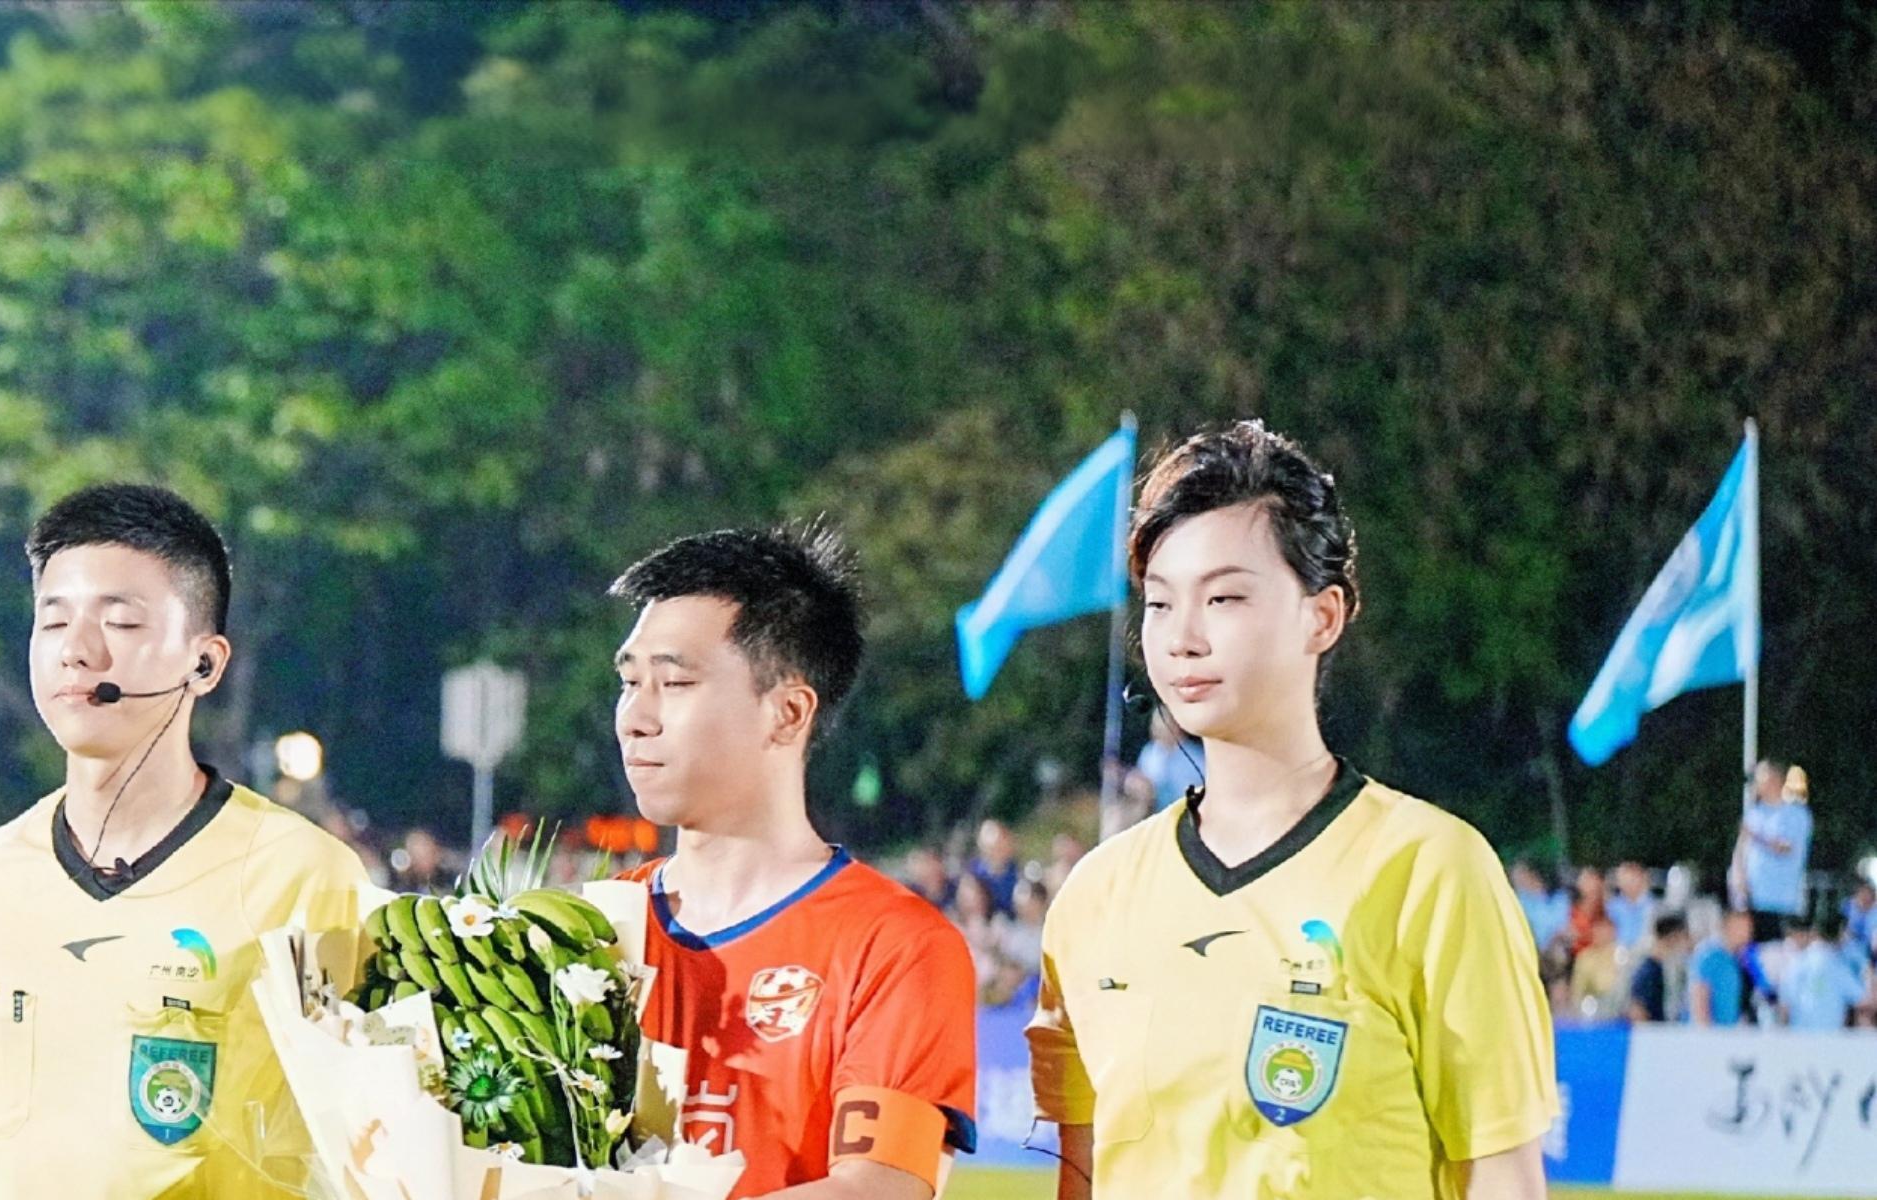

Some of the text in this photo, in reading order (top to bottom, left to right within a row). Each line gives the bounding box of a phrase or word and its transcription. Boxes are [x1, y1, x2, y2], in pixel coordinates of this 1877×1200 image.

[1262, 1015, 1339, 1045] REFEREE
[139, 1043, 210, 1064] REFEREE
[1274, 1107, 1286, 1121] 2
[833, 1100, 880, 1156] C
